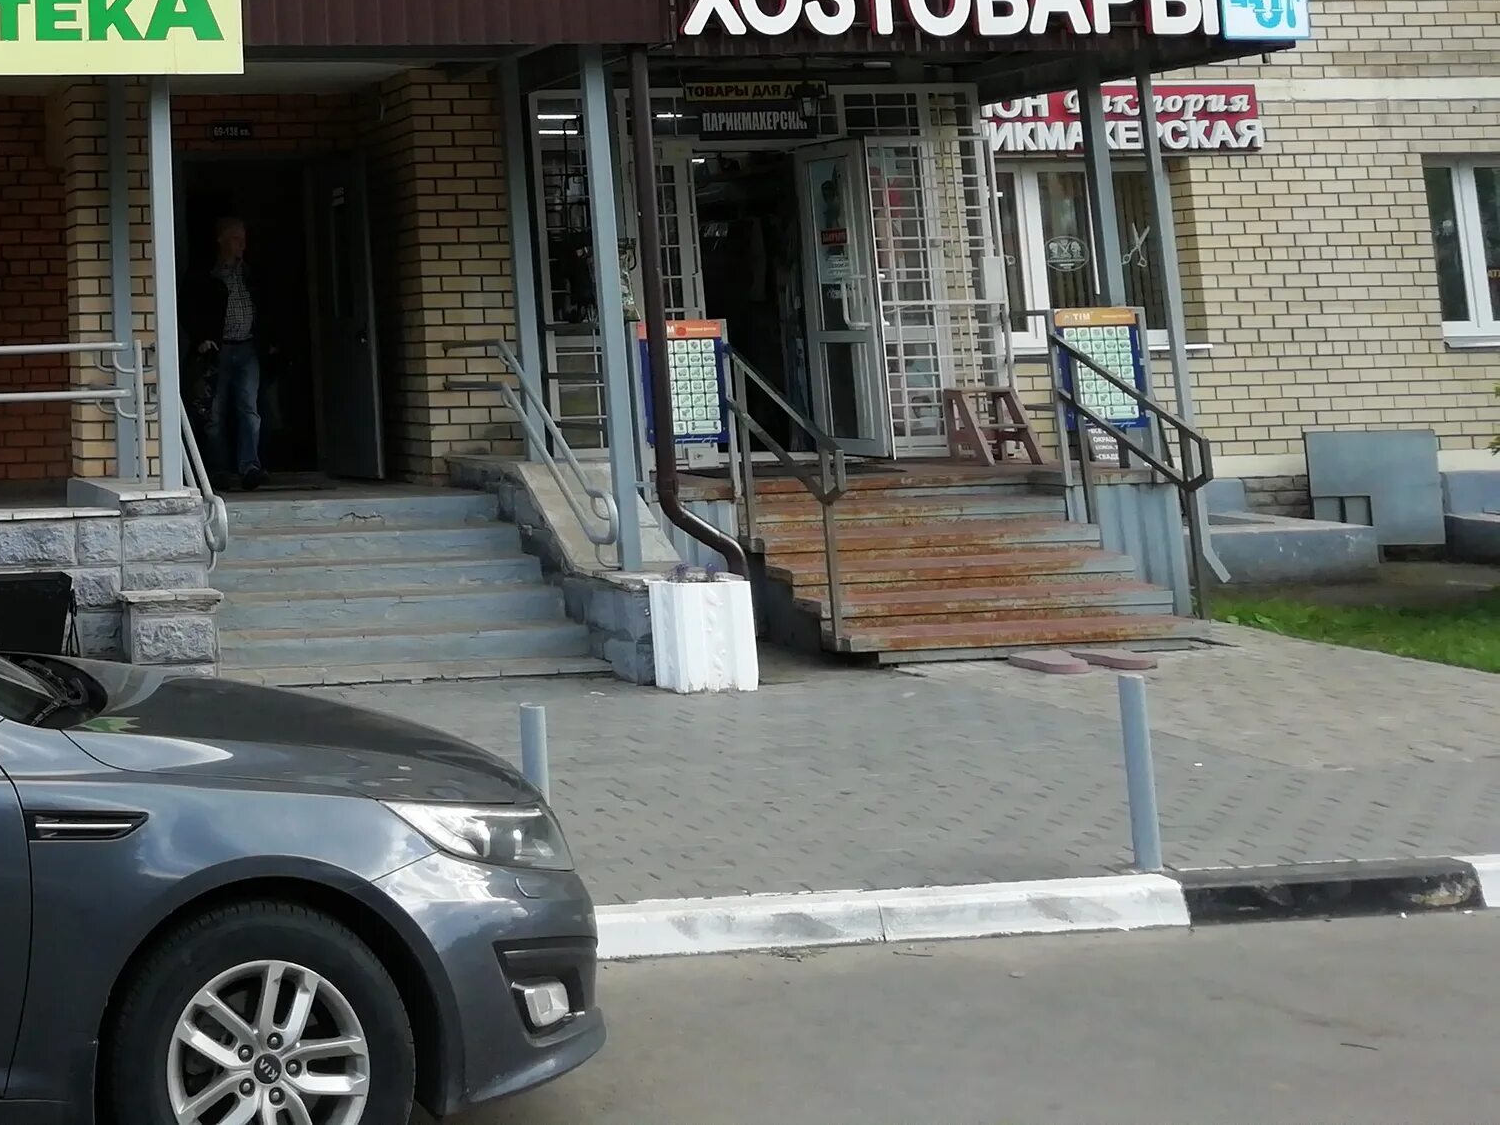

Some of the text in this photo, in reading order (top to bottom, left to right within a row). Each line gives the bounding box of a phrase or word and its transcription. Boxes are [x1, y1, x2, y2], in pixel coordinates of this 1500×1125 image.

[687, 84, 749, 98] ТОВАРЫ
[752, 84, 781, 98] ДЛЯ
[260, 1058, 278, 1080] KIA
